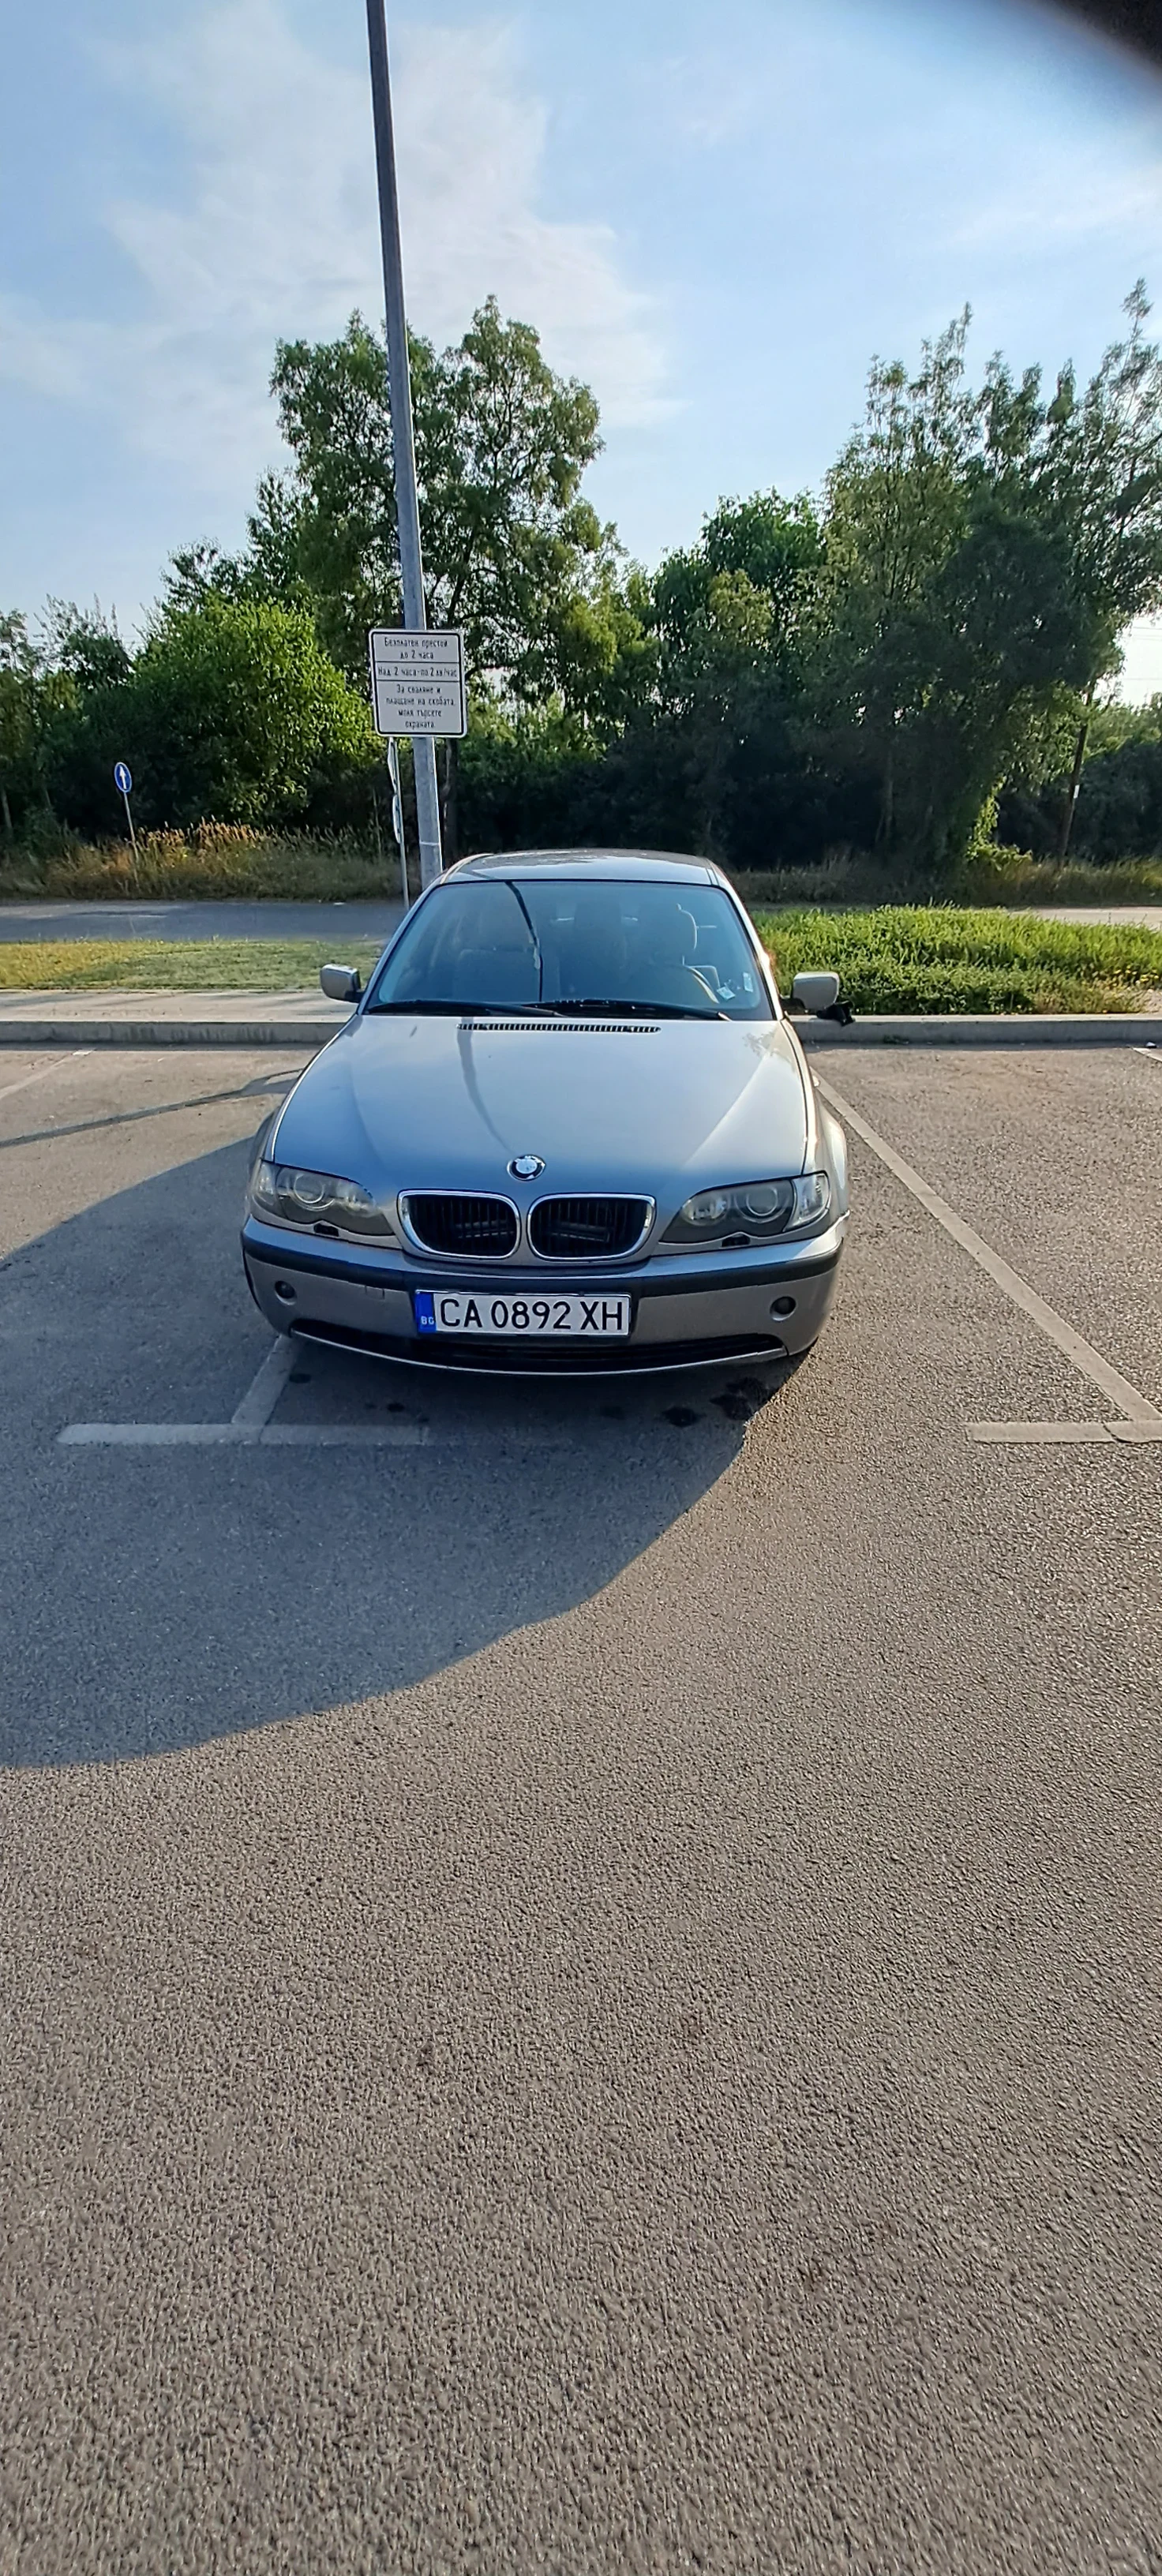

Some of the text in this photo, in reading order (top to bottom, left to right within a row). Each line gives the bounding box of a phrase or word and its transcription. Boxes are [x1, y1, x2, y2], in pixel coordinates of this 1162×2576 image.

[384, 637, 448, 649] Безплатен престой
[411, 650, 416, 659] 2
[378, 667, 392, 676] Над
[394, 667, 399, 676] 2
[430, 668, 434, 676] 2
[396, 684, 404, 694] За
[417, 710, 442, 719] търсете
[421, 1298, 623, 1331] BG CA 0892 XH
